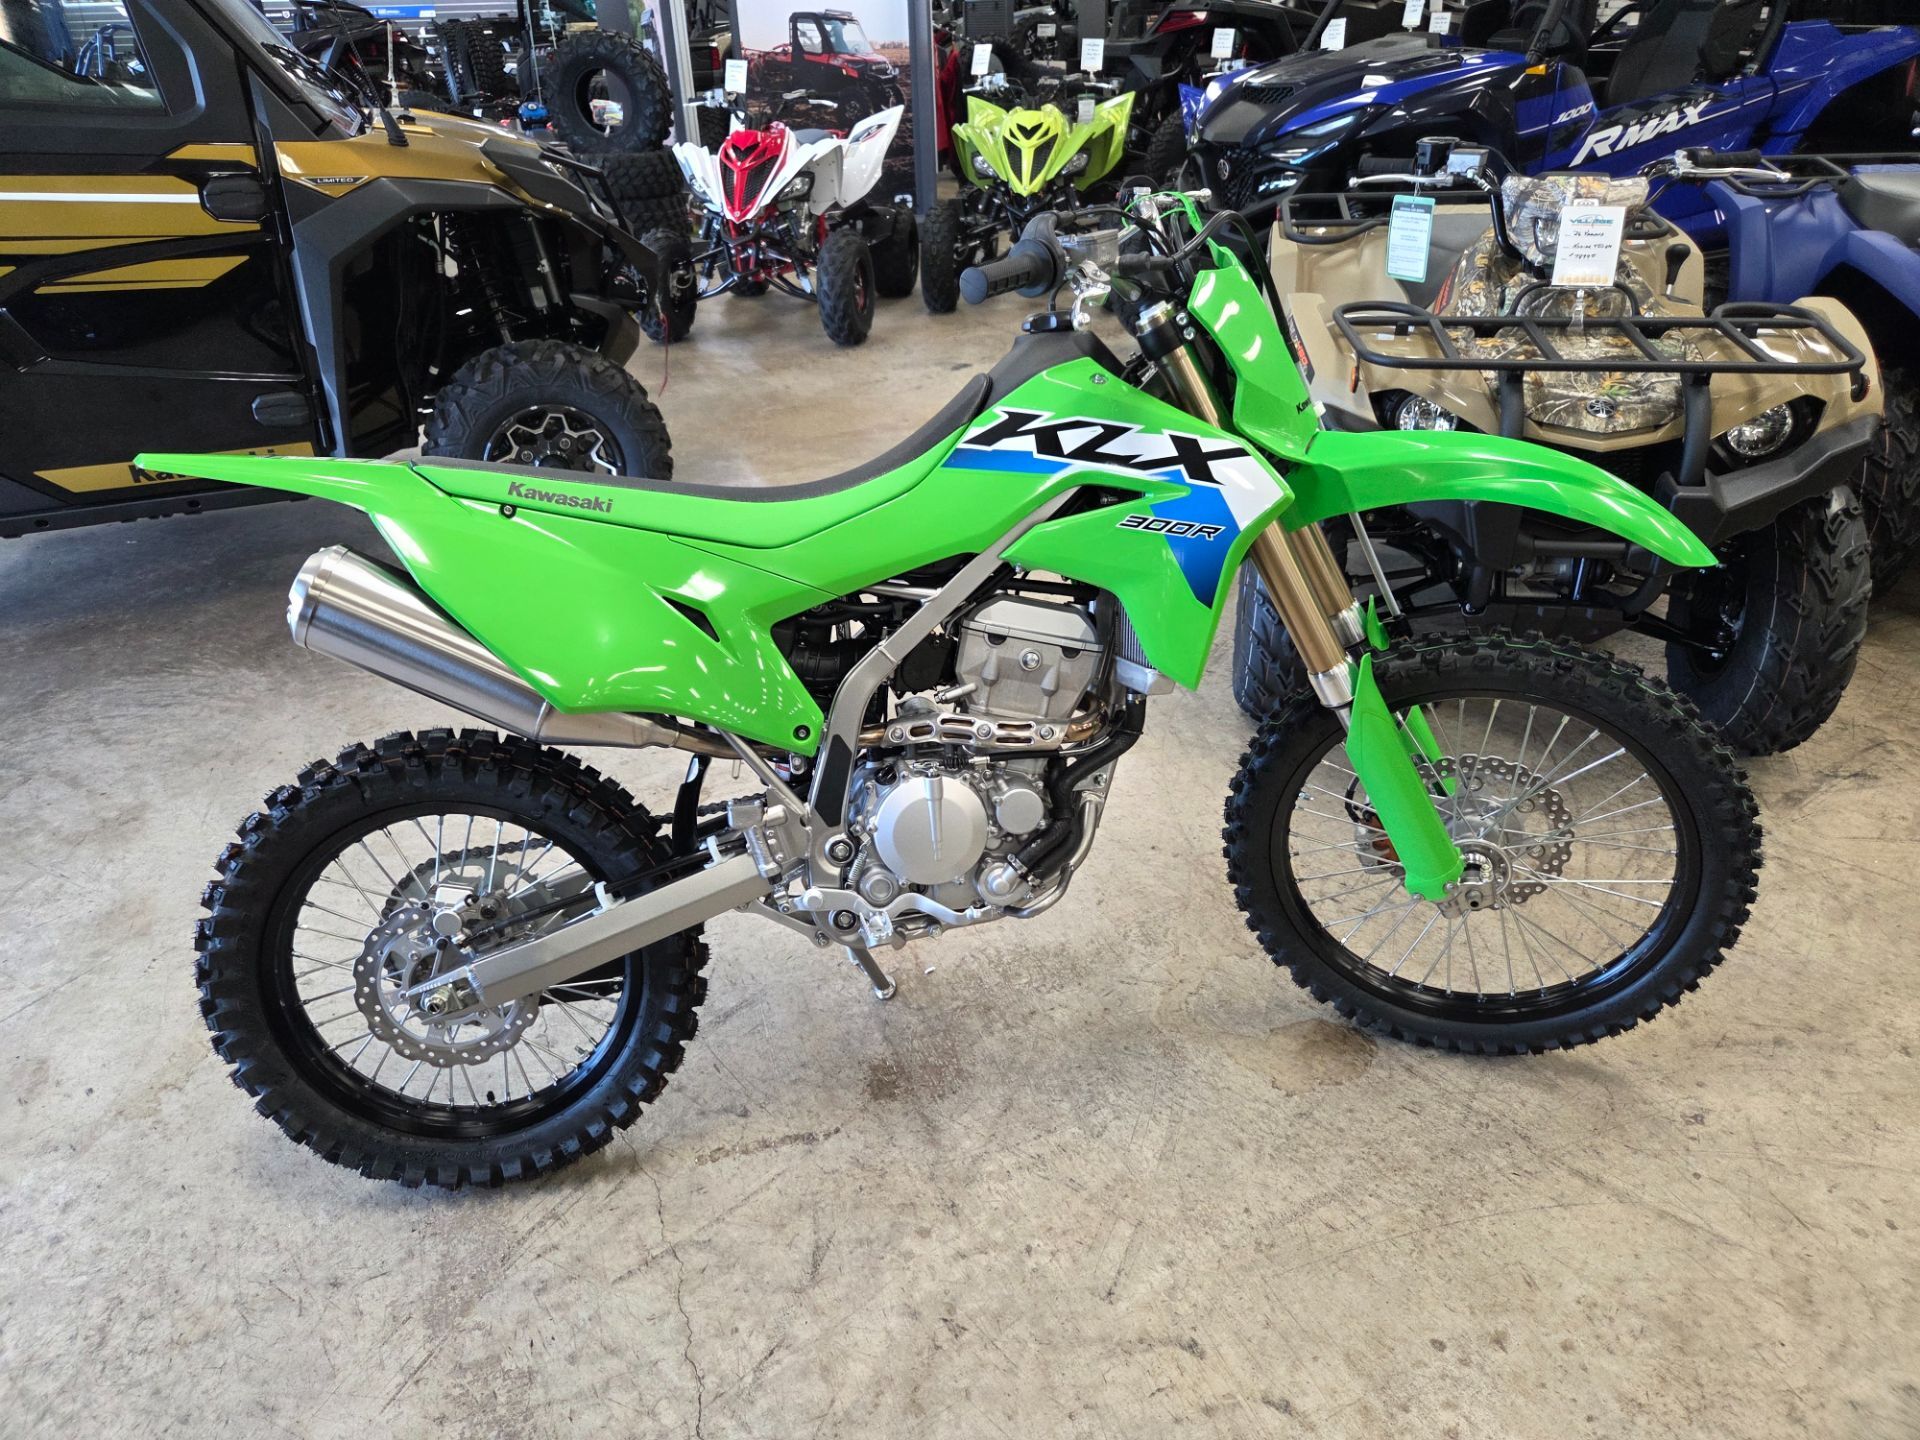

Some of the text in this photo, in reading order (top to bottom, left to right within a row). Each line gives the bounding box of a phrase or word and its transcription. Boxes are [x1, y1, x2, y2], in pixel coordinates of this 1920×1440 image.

[1552, 101, 1593, 125] 1000
[1568, 99, 1711, 168] RMAX
[962, 410, 1251, 486] KLX
[508, 481, 613, 513] Kawasaki
[1117, 514, 1224, 541] 300R
